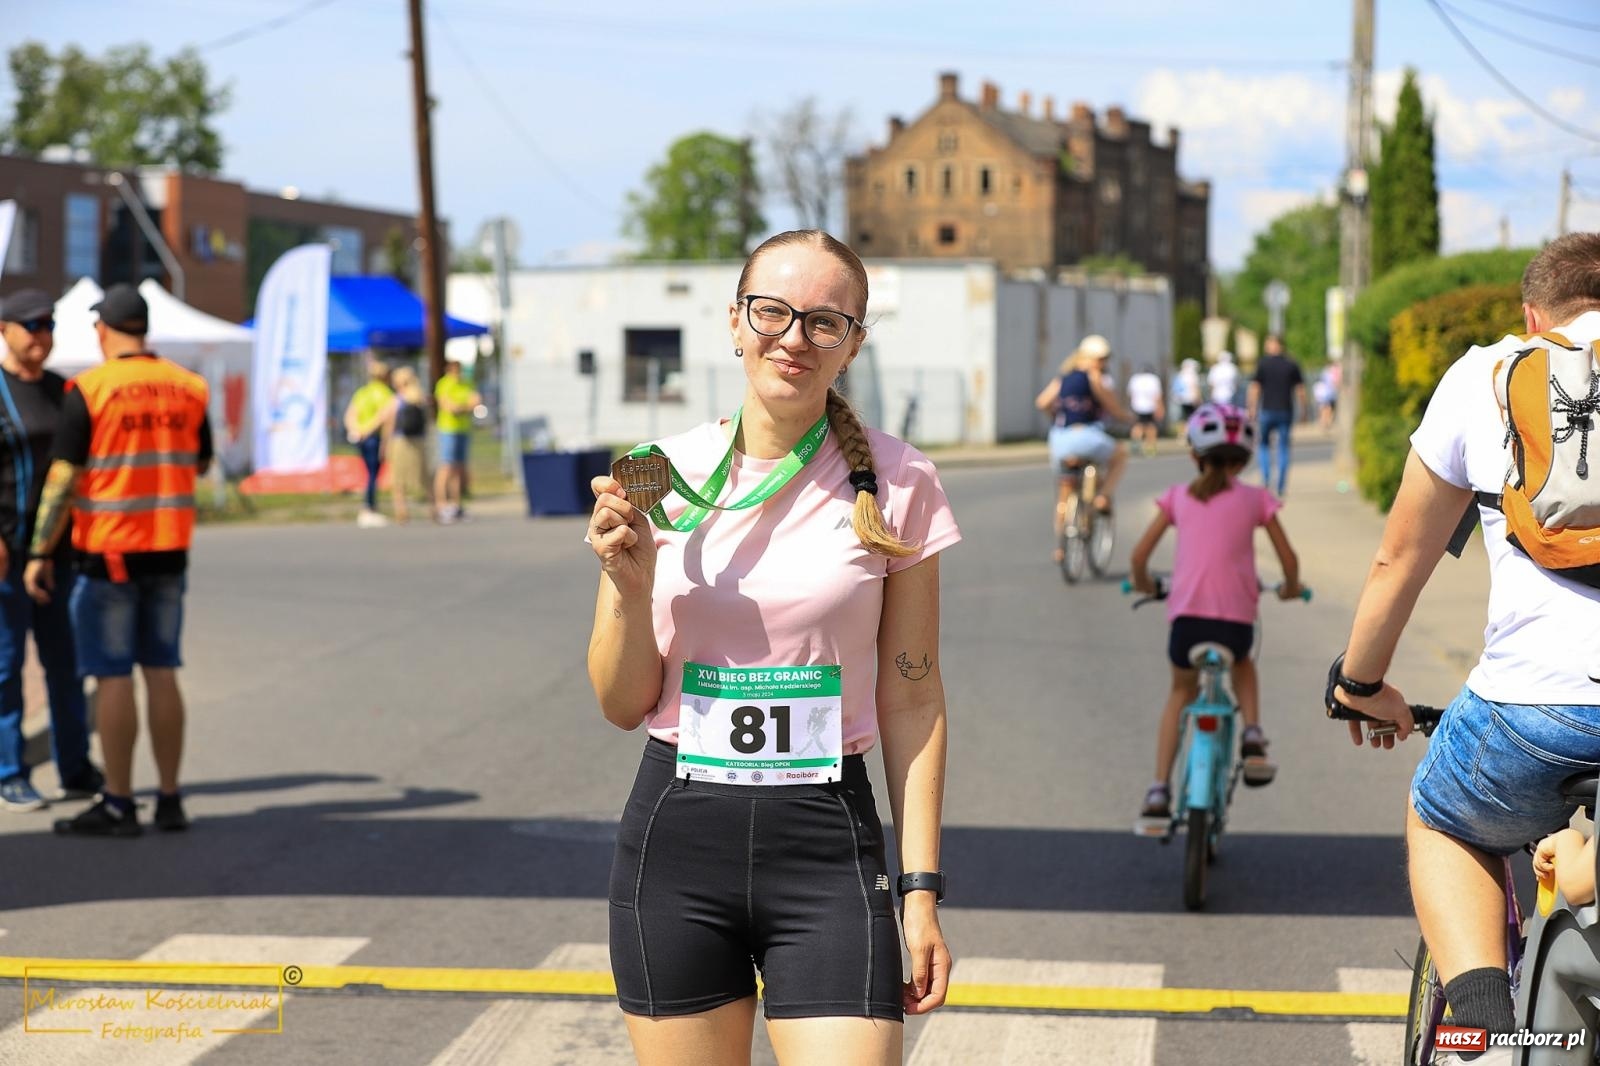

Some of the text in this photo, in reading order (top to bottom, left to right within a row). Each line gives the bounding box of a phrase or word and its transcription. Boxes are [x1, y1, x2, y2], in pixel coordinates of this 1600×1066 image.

[697, 668, 822, 683] XVI BIEG BEZ GRANIC
[730, 705, 790, 754] 81
[786, 771, 819, 780] Racibórz
